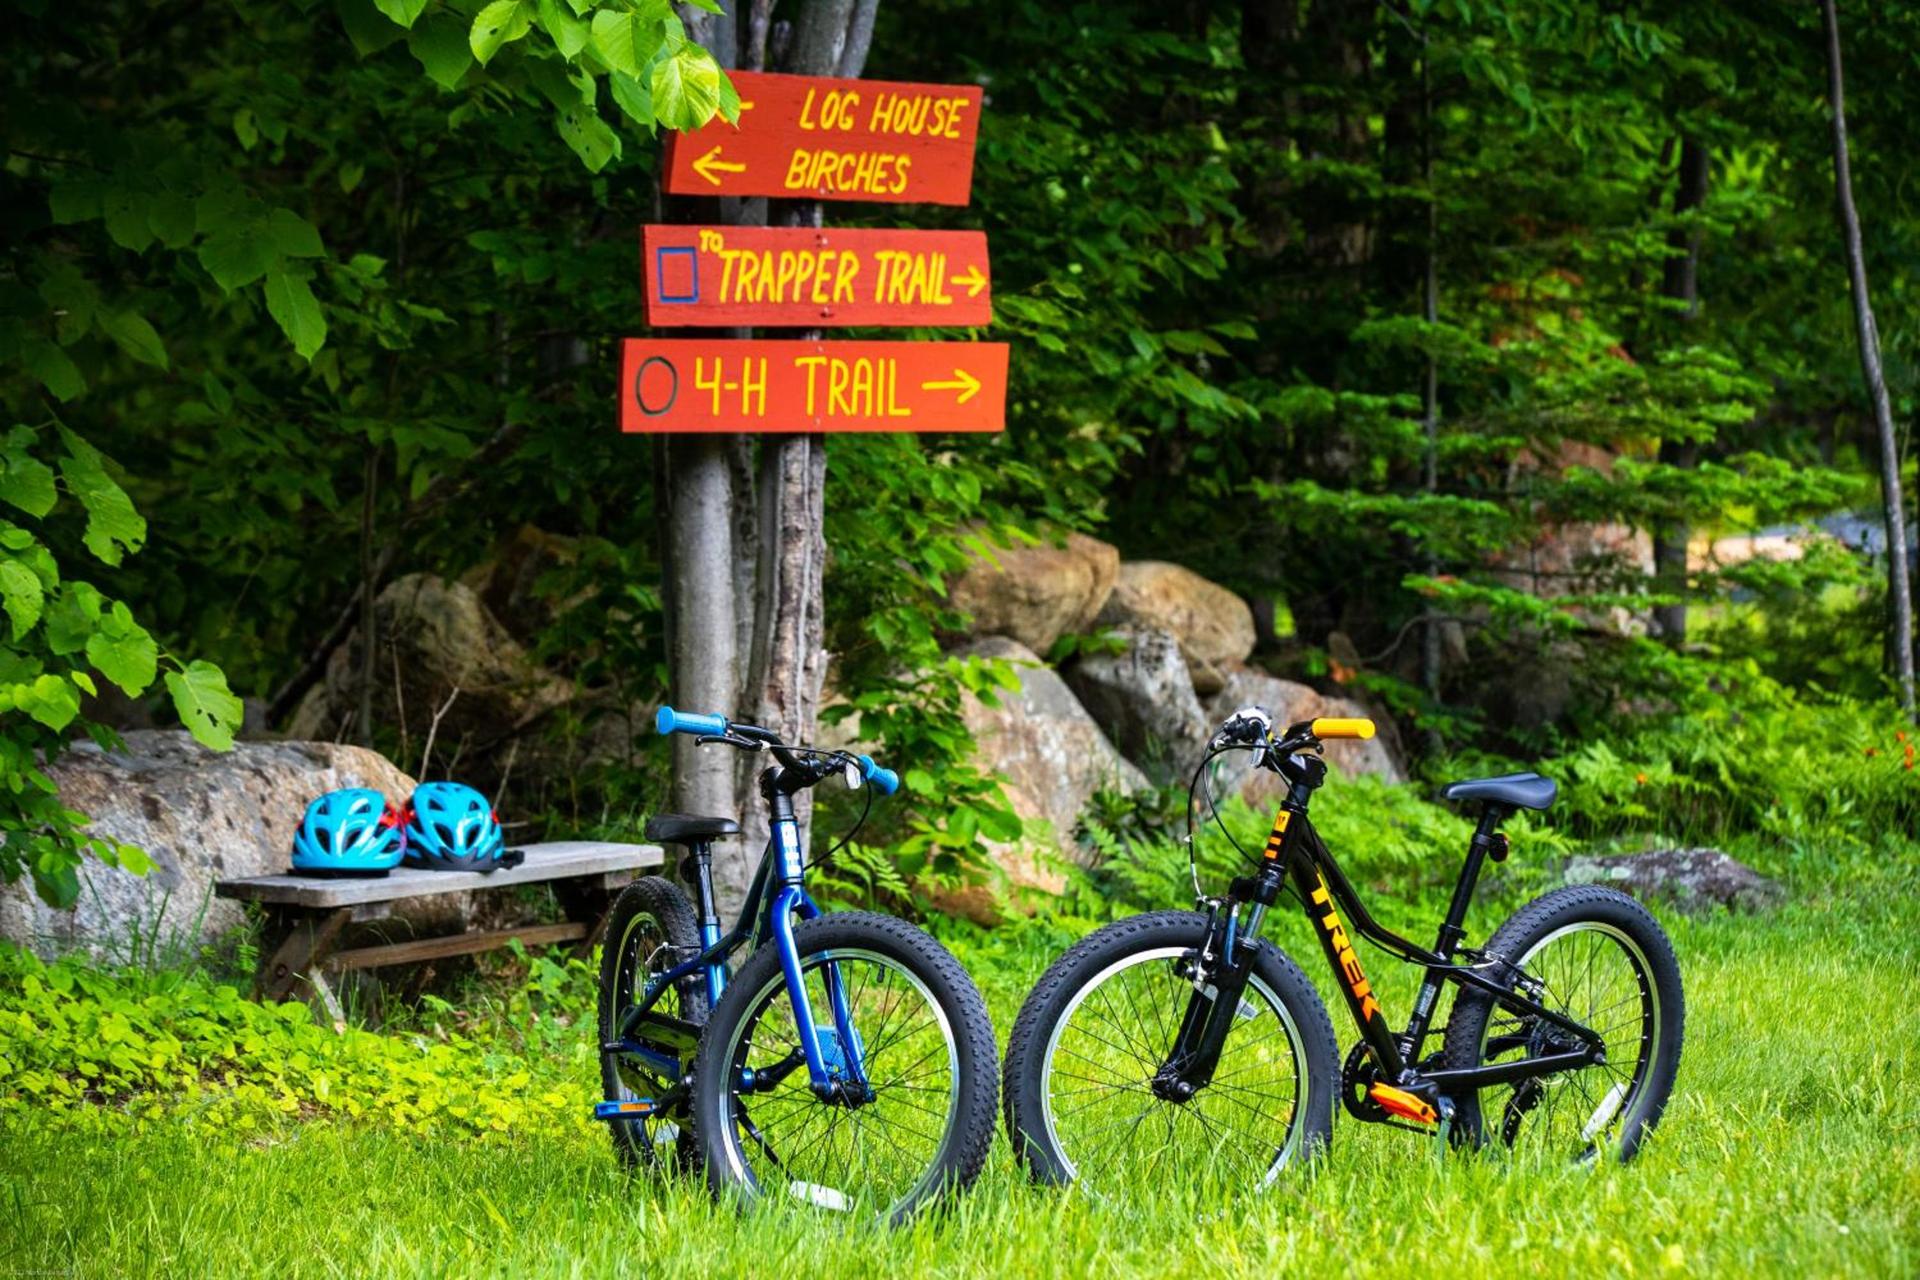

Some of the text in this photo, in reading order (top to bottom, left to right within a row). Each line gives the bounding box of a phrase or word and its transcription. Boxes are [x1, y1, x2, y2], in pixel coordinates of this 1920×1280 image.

[800, 88, 970, 139] LOG HOUSE
[785, 149, 912, 195] BIRCHES
[699, 229, 954, 306] TO TRAPPER TRAIL
[695, 356, 912, 417] 4-H TRAIL
[1311, 872, 1381, 1023] TREK
